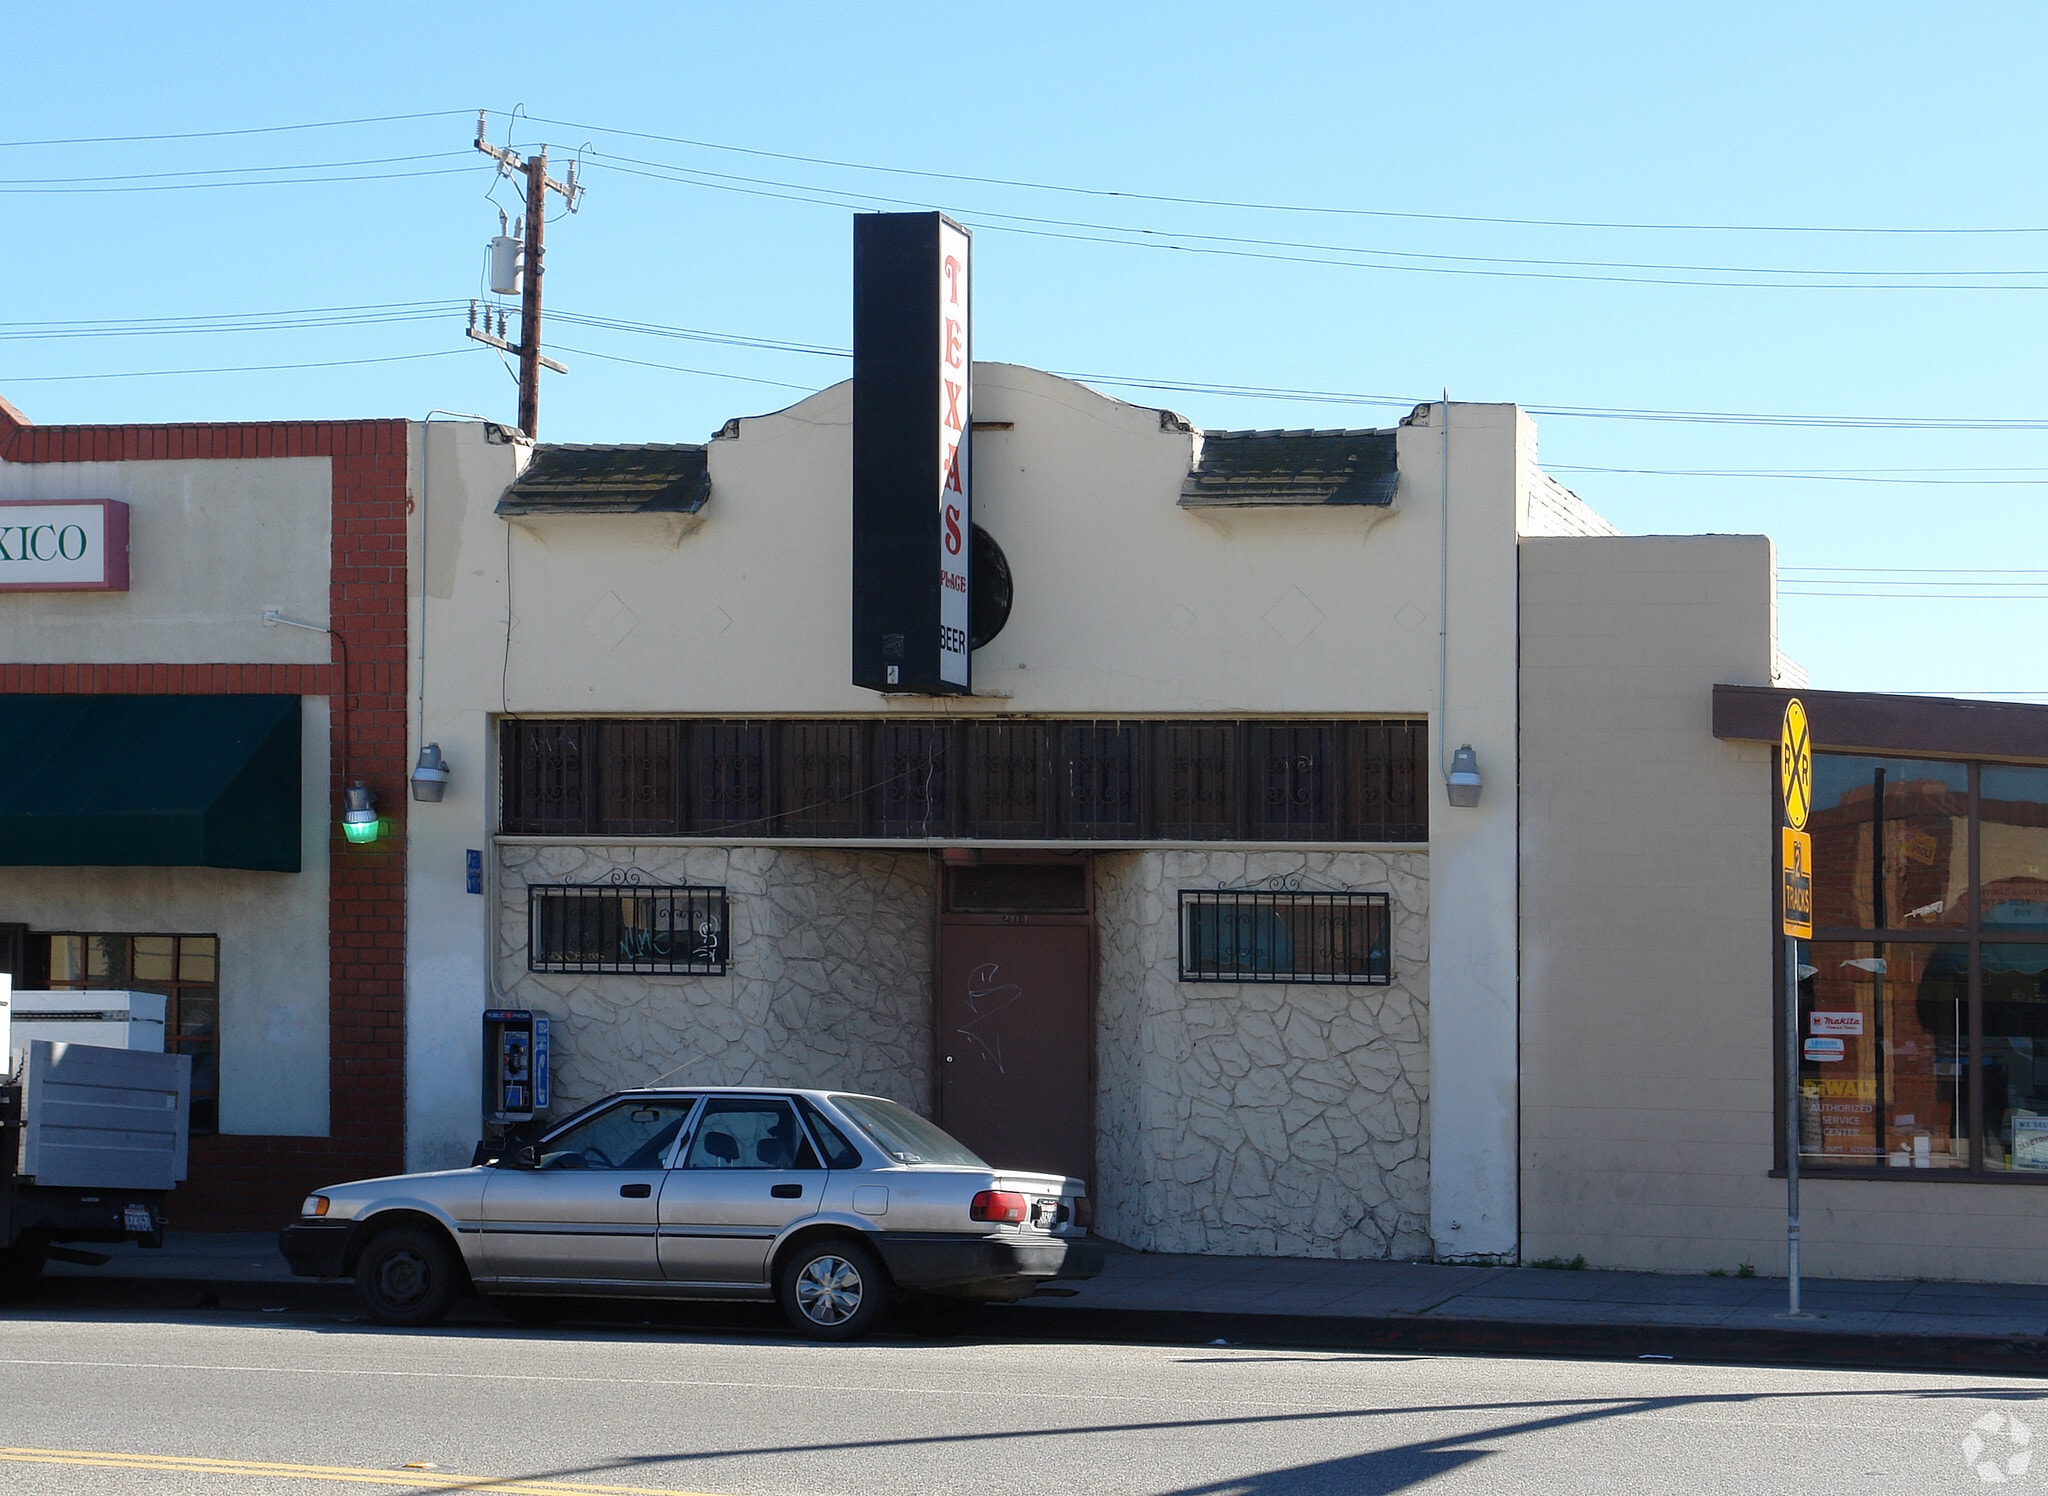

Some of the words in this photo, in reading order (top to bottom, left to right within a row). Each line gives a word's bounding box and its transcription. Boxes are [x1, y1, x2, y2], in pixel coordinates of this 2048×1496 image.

[944, 254, 963, 555] TEXAS
[940, 569, 967, 594] PLACE
[940, 624, 966, 656] BEER
[1911, 842, 1933, 860] TOOLS
[1785, 883, 1811, 915] TRACKS
[1809, 1103, 1873, 1113] AUTHORIZED
[1822, 1115, 1860, 1125] SERVICE
[1823, 1127, 1859, 1136] CENTER
